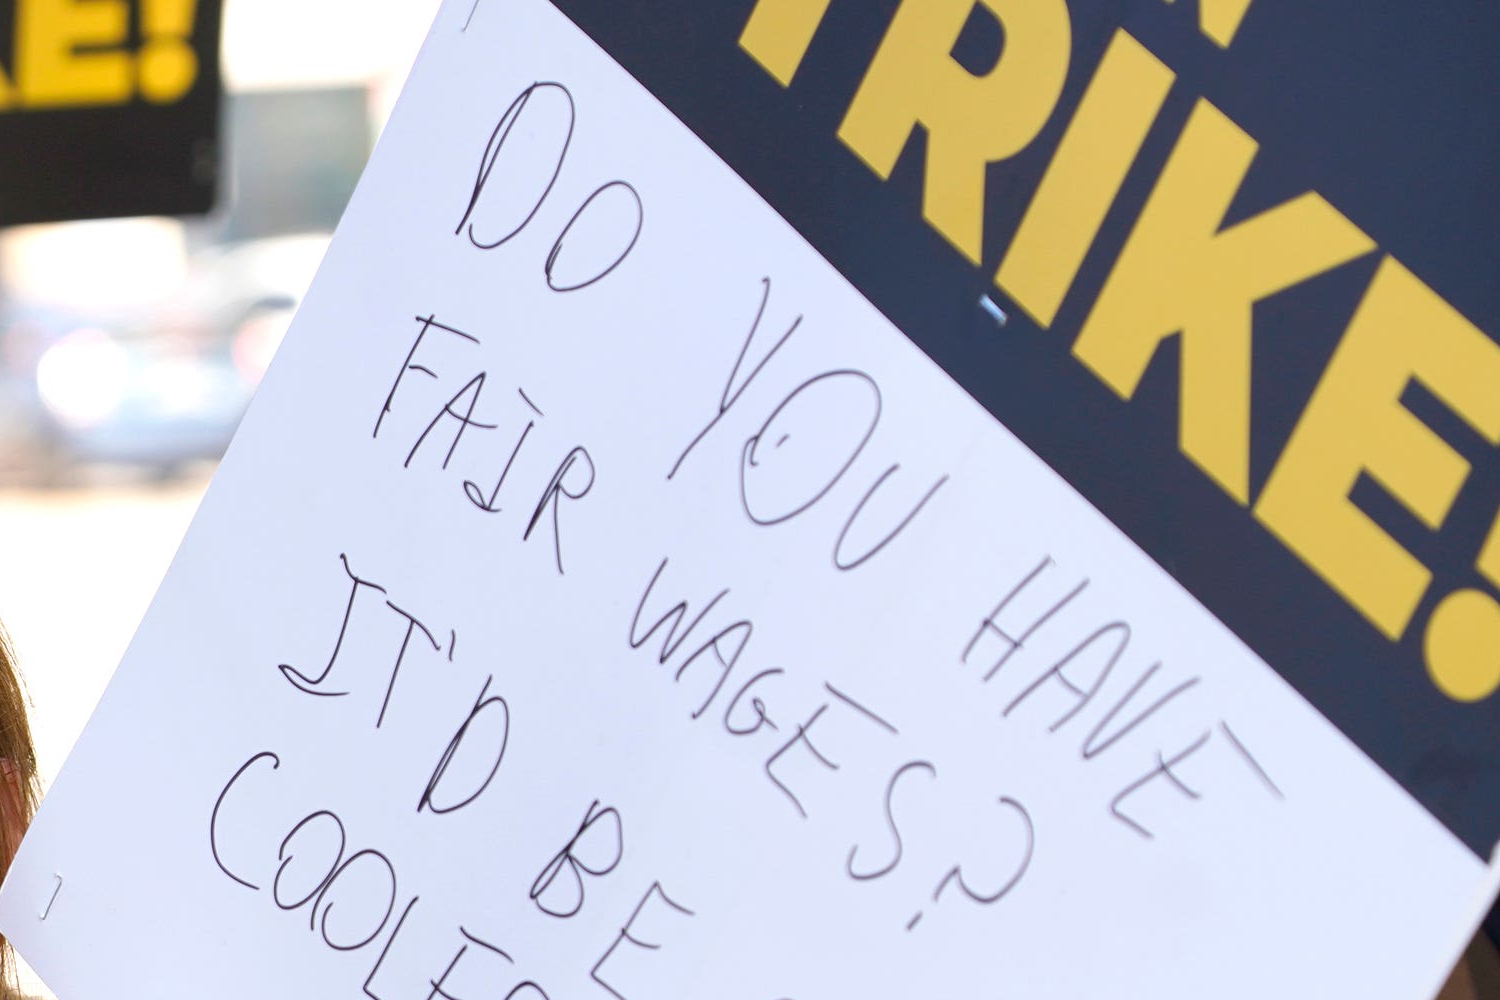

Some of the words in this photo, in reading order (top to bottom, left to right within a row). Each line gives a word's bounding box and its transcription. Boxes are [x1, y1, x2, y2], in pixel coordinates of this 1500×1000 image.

[372, 313, 596, 575] FAIR
[628, 556, 1035, 932] WAGES?
[454, 80, 643, 292] DO
[666, 275, 950, 572] YOU
[957, 554, 1286, 840] HAVE
[736, 0, 1500, 703] RIKE
